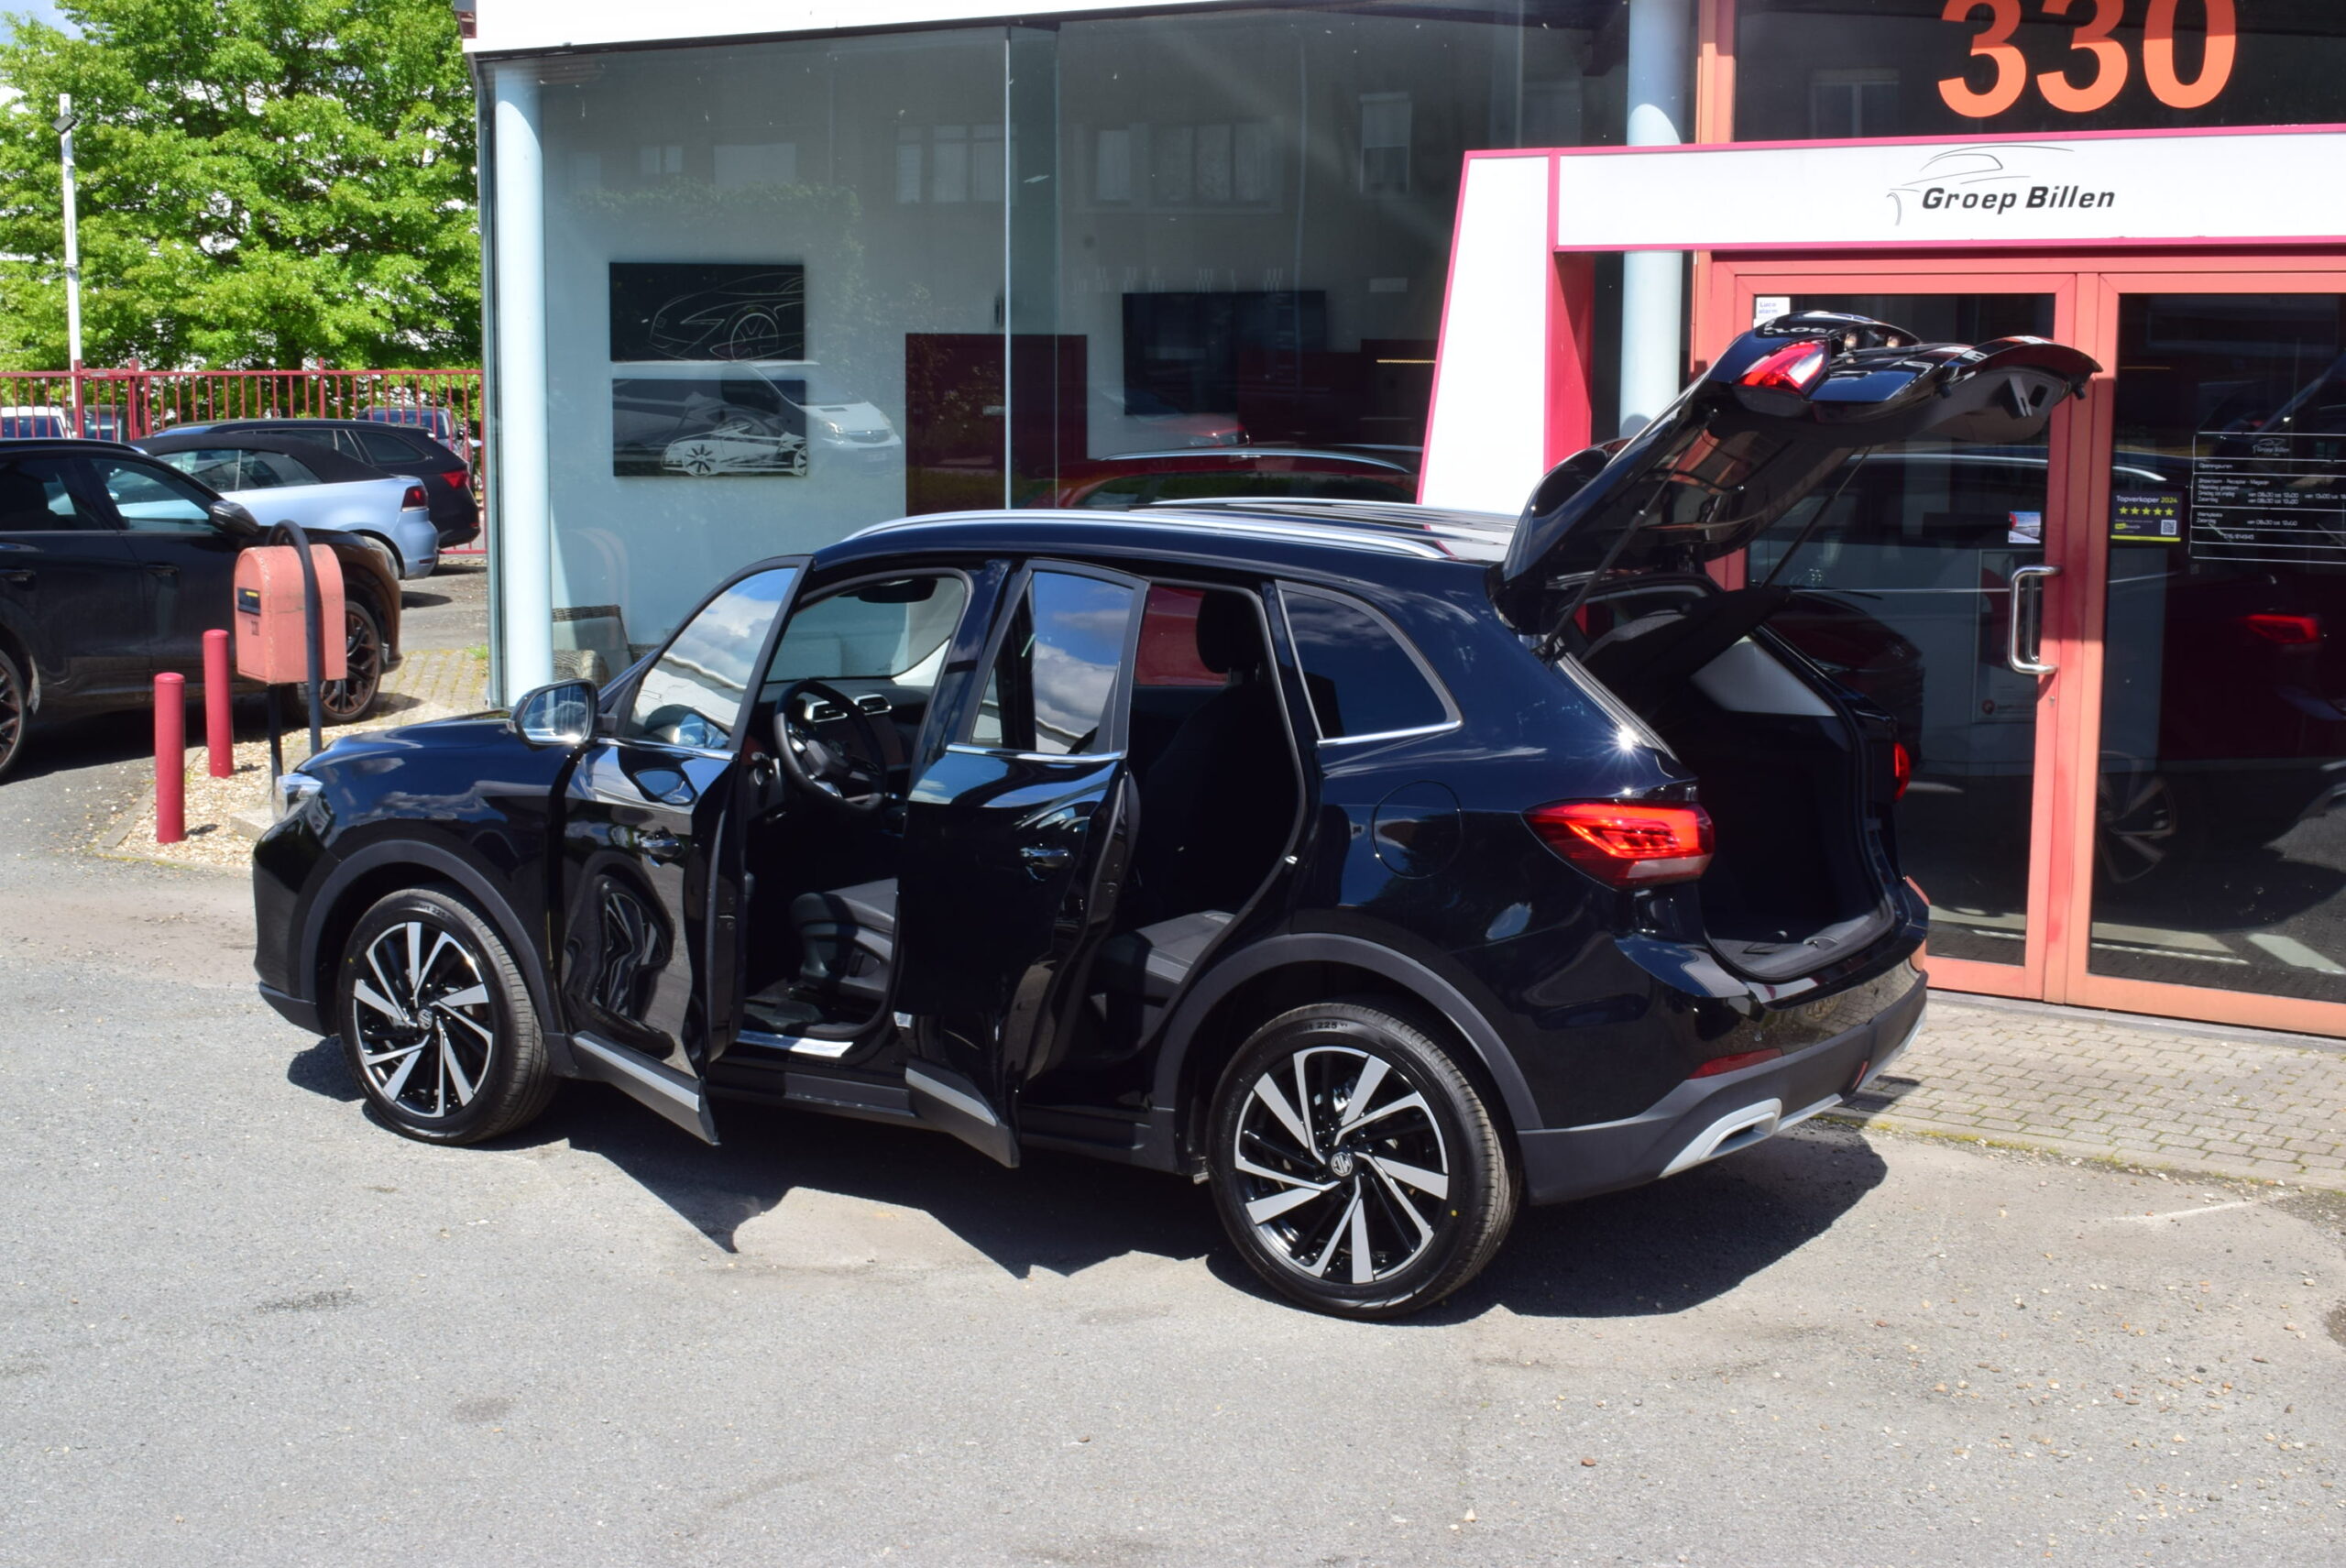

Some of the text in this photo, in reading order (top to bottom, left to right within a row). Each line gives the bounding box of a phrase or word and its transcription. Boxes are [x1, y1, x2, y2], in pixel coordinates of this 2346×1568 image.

[1937, 0, 2236, 117] 330
[1921, 183, 2116, 215] Groep Billen
[2116, 495, 2178, 504] Topverkoper 2024
